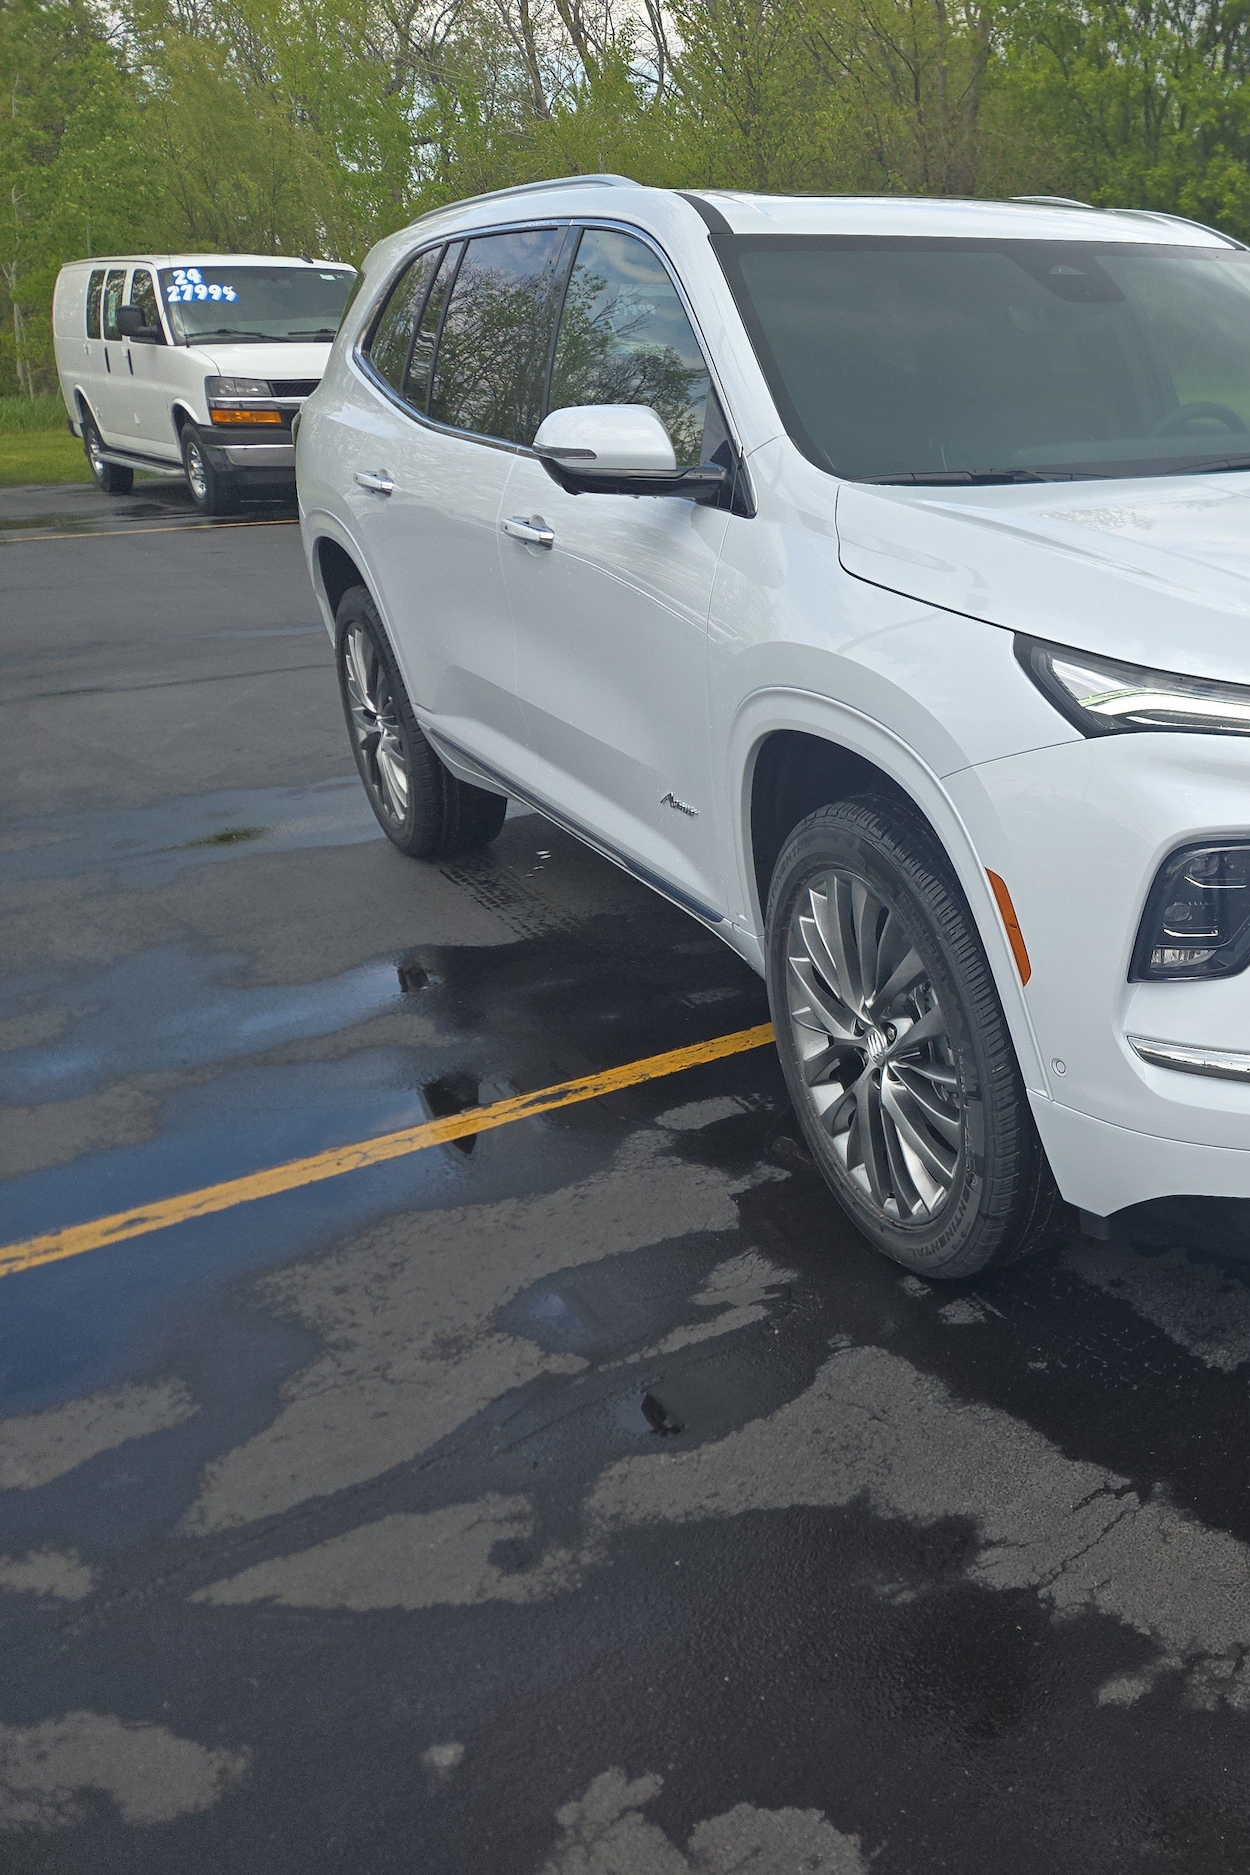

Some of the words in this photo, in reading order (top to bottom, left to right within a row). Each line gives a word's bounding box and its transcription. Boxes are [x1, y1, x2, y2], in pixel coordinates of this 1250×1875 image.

[172, 268, 202, 285] 24
[166, 284, 237, 302] 27995
[905, 1185, 972, 1258] NTINENTAL
